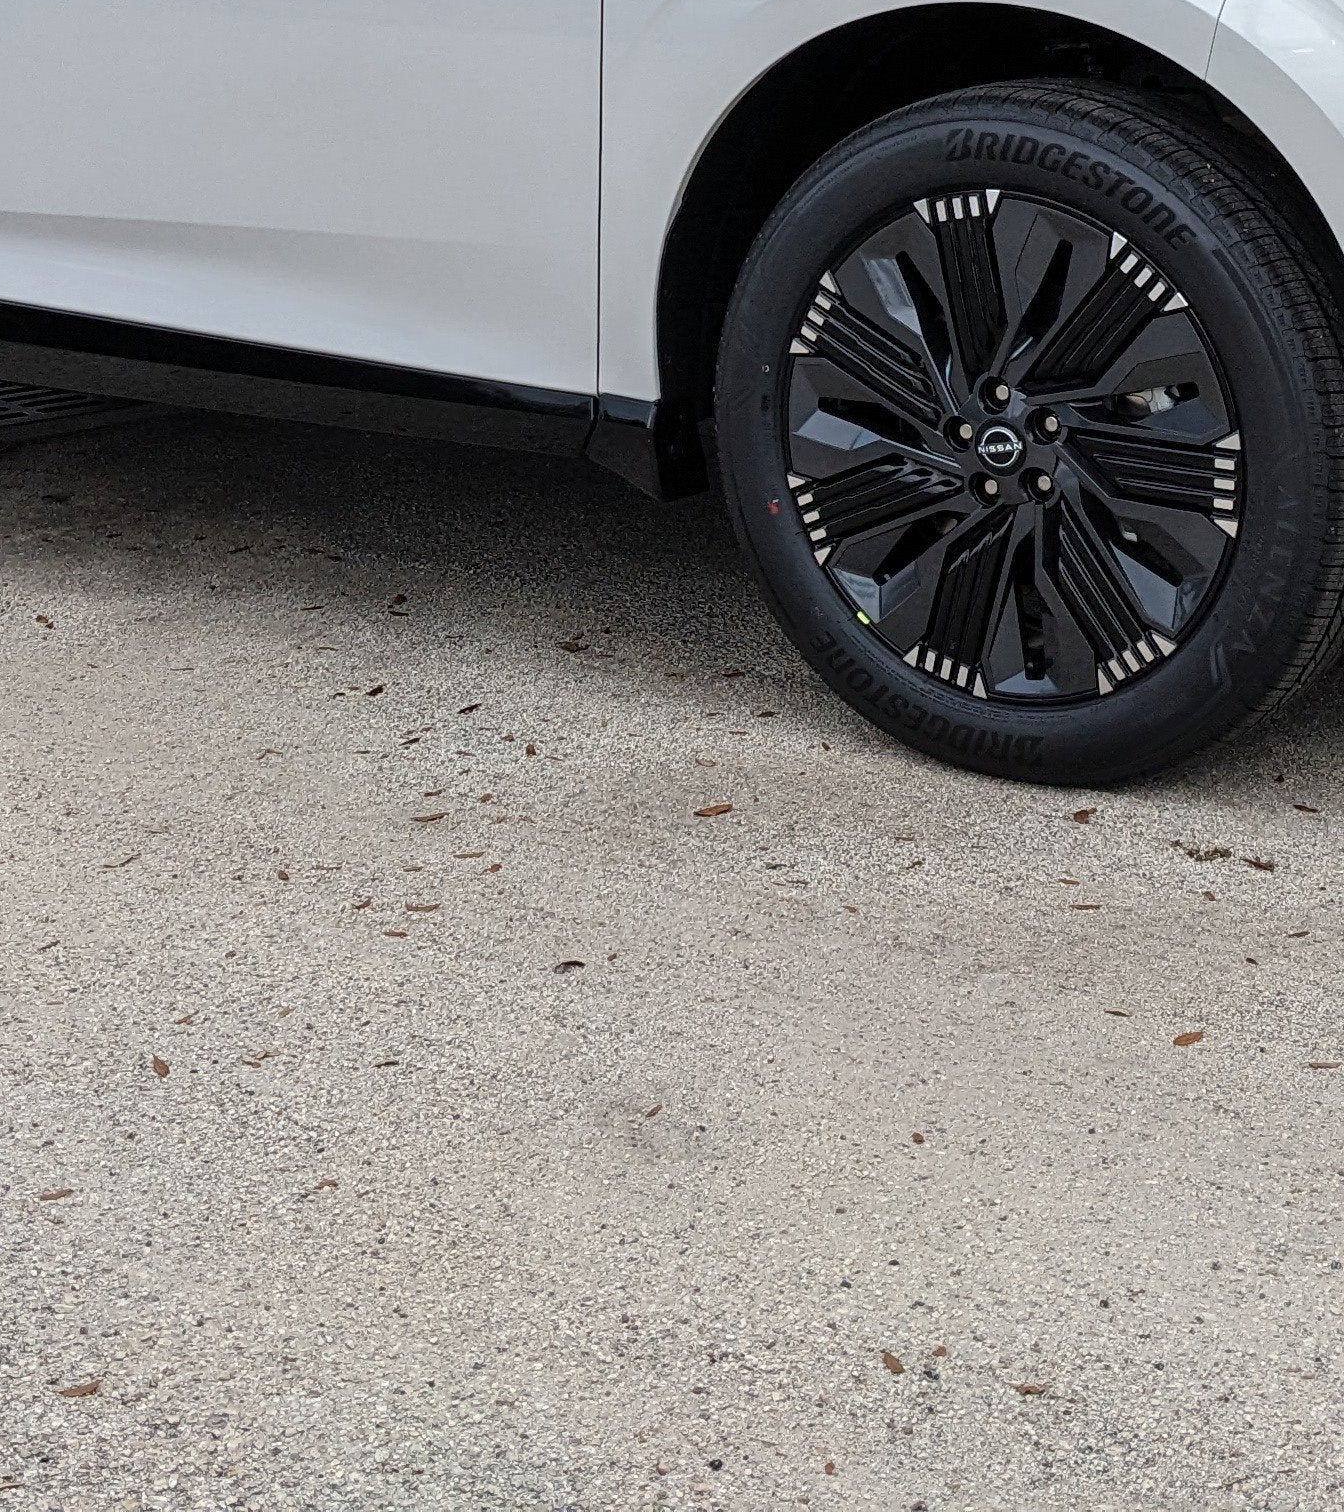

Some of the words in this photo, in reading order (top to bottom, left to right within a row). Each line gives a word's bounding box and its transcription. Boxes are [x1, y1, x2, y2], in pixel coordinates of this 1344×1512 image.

[944, 127, 1198, 251] BRIDGESTONE
[977, 441, 1023, 455] NISSAN
[809, 630, 1045, 768] BRIDGESTONE
